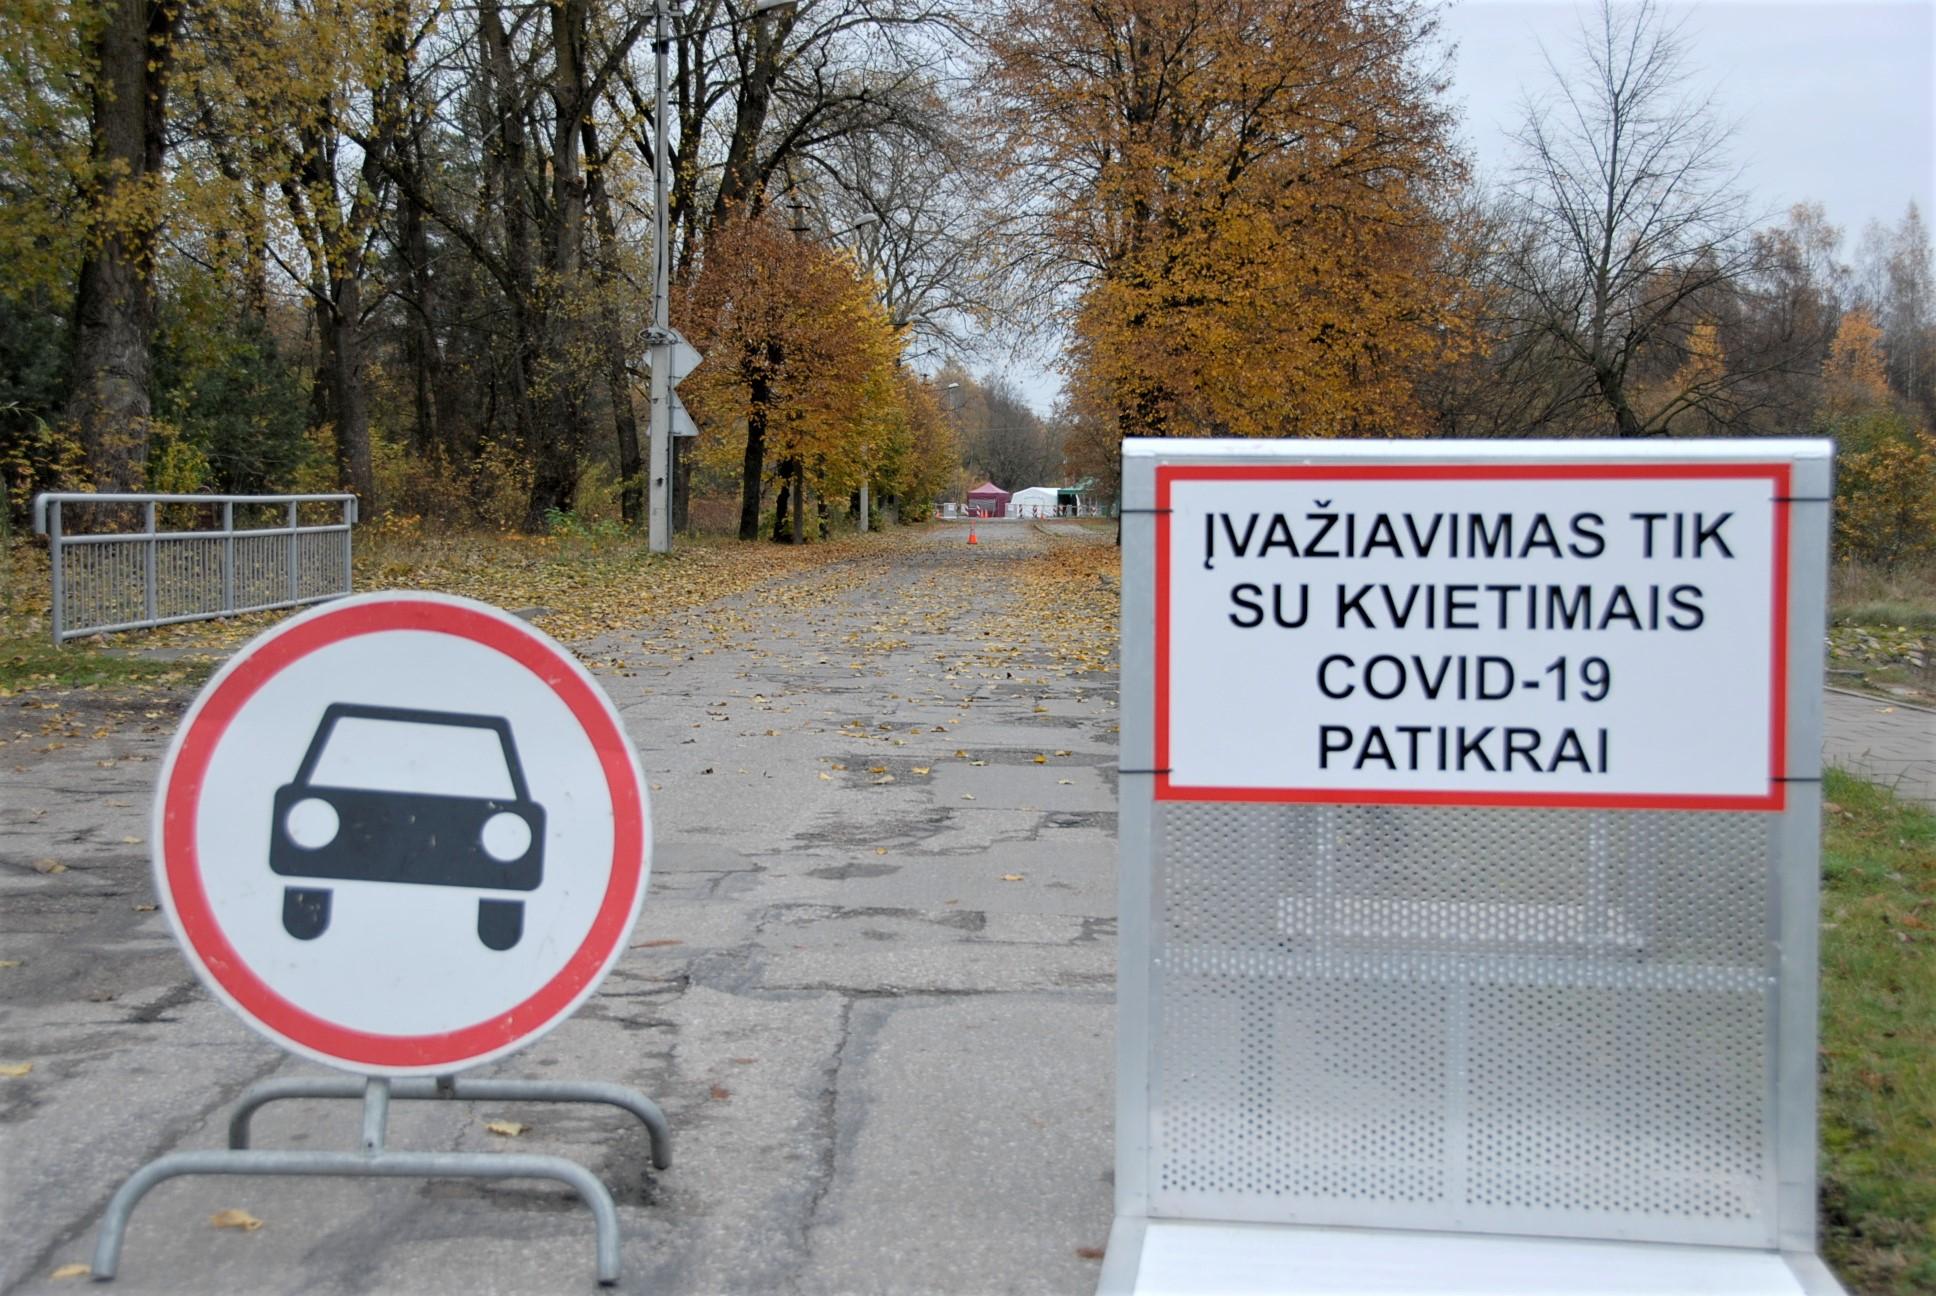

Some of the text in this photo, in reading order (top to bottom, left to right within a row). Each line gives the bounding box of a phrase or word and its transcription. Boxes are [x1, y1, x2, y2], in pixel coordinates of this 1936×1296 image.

[1203, 499, 1736, 571] ĮVAŽIAVIMAS TIK
[1228, 582, 1706, 632] SU KVIETIMAIS
[1317, 653, 1612, 704] COVID-19
[1319, 724, 1608, 775] PATIKRAI
